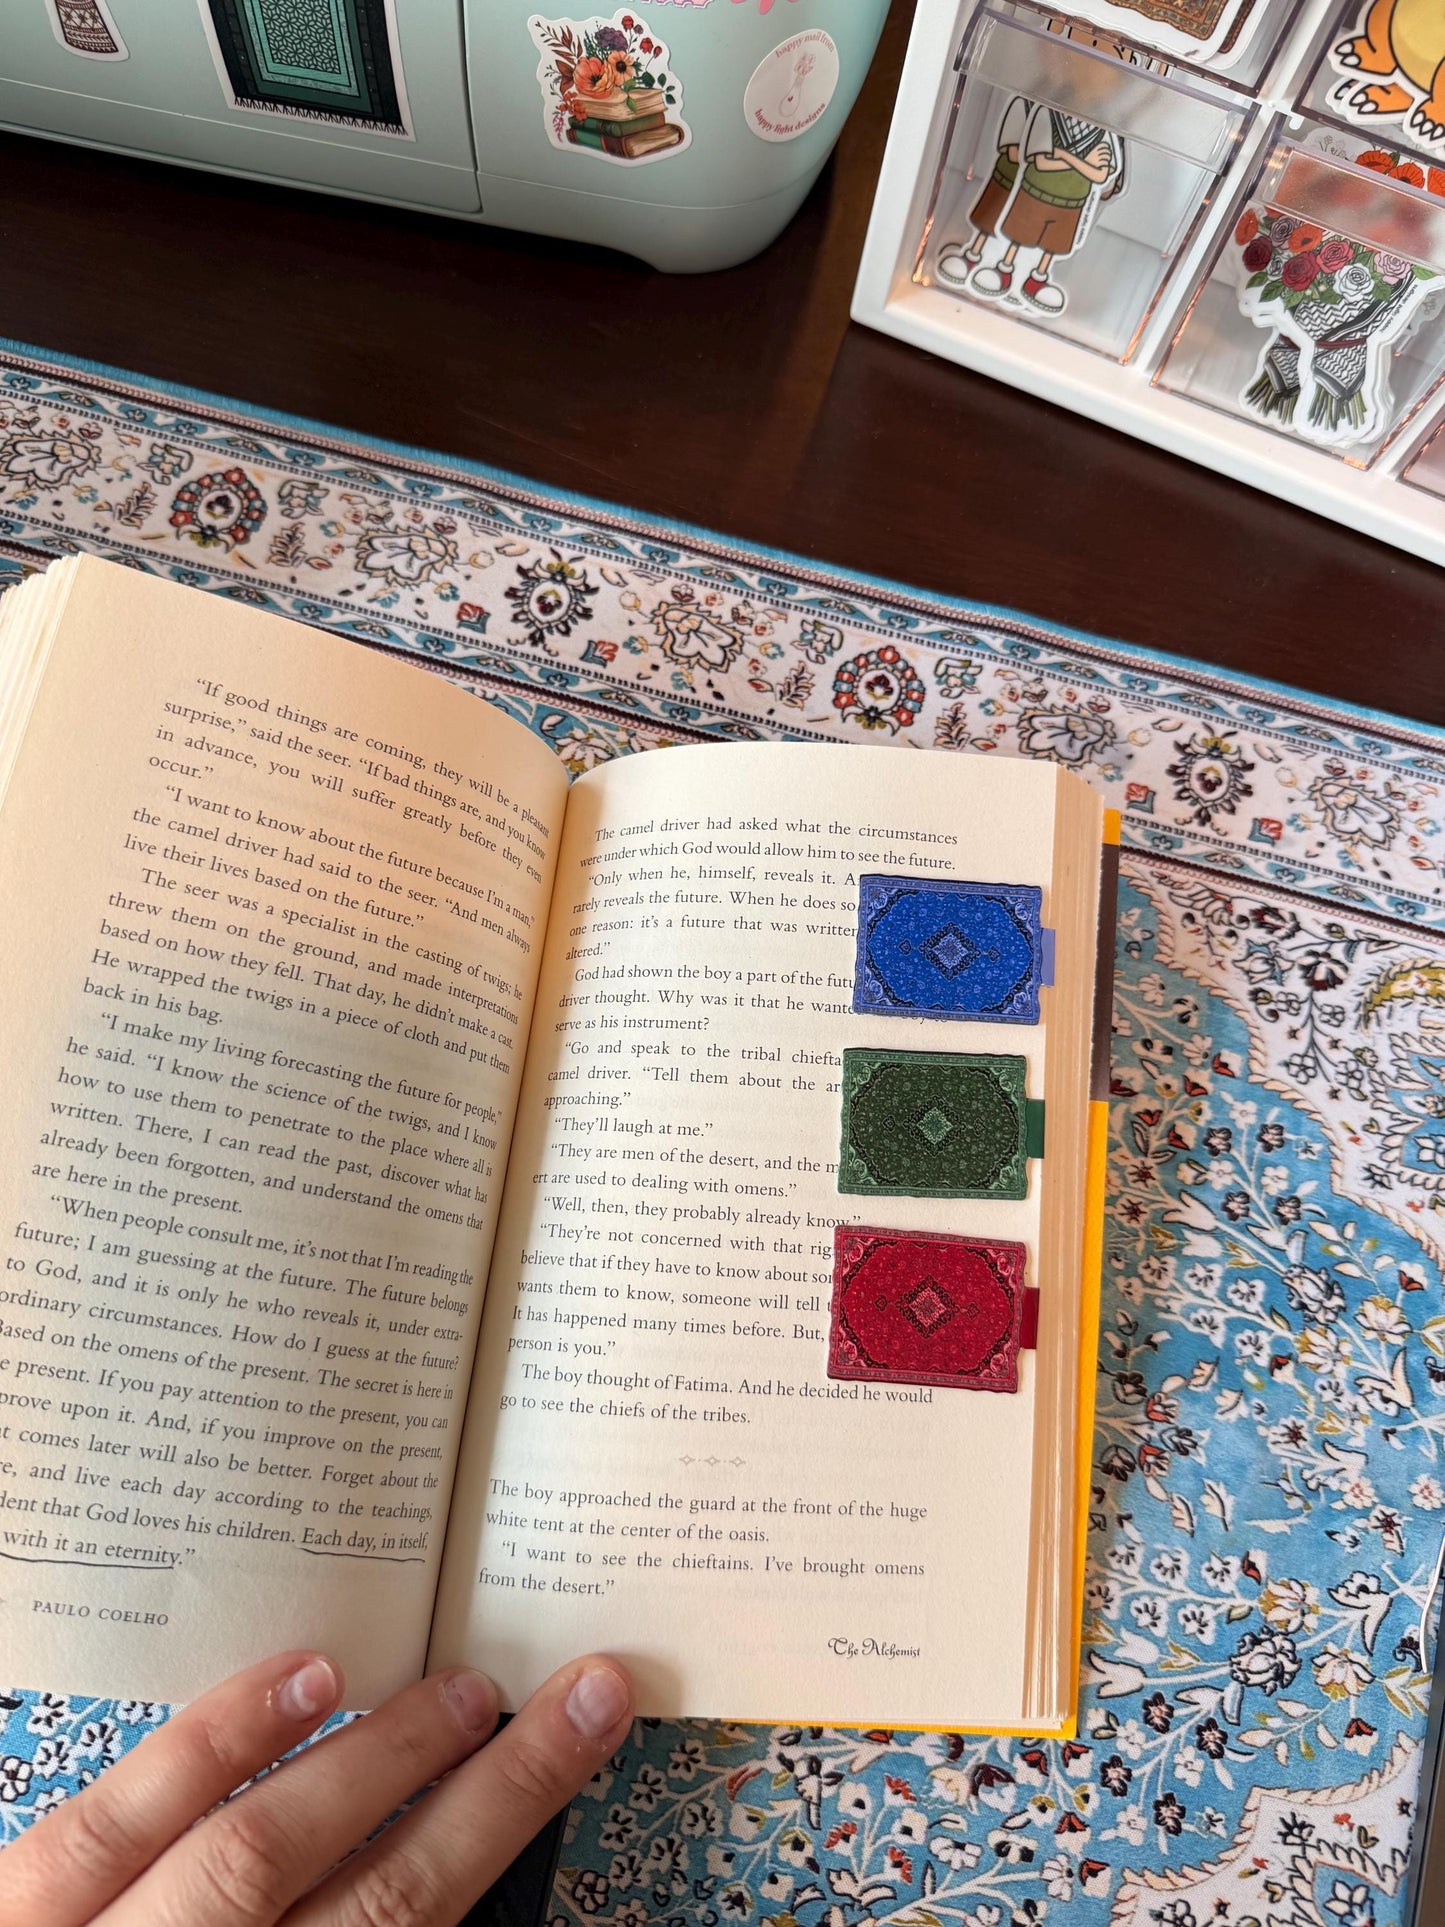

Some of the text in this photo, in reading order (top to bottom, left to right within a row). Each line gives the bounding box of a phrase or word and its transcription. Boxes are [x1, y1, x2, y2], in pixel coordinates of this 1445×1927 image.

[775, 37, 804, 58] happy
[755, 103, 825, 135] happy light designs
[149, 757, 214, 779] occur."
[197, 679, 549, 838] "If good things are coming, they will be a pleasant
[595, 817, 958, 845] The camel driver had asked what the circumstances
[580, 841, 956, 870] were under which God would allow him to see the future.
[124, 833, 424, 927] live their lives based on the future."
[566, 942, 611, 961] altered."
[83, 977, 223, 1026] back in his bag.
[555, 1015, 710, 1033] serve as his instrument?
[544, 1091, 631, 1110] approaching."
[555, 1117, 713, 1137] "They'll laugh at me."
[32, 1164, 242, 1213] are here in the present.
[533, 1171, 797, 1198] ert are used to dealing with omens."
[6, 1257, 463, 1341] to God, and it is only he who reveals it, under extra-
[508, 1337, 616, 1358] person is you."
[522, 1363, 933, 1403] The boy thought of Fatima. And he decided he would
[500, 1396, 751, 1423] go to see the chiefs of the tribes.
[490, 1479, 927, 1522] The boy approached the guard at the front of the huge
[43, 1497, 81, 1518] that
[86, 1503, 129, 1524] God
[132, 1508, 180, 1531] loves
[185, 1514, 212, 1534] his
[216, 1519, 295, 1543] children.
[301, 1527, 342, 1546] Each
[347, 1531, 376, 1553] day,
[381, 1532, 396, 1549] in
[399, 1532, 429, 1549] itself,
[487, 1510, 769, 1542] white tent at the center of the oasis.
[3, 1529, 196, 1567] with it an eternity."
[502, 1542, 925, 1578] "I want to see the chieftains. I've brought omens
[479, 1568, 615, 1595] from the desert."
[33, 1600, 169, 1626] PAULO COELHO
[828, 1637, 920, 1660] The Alchemist
